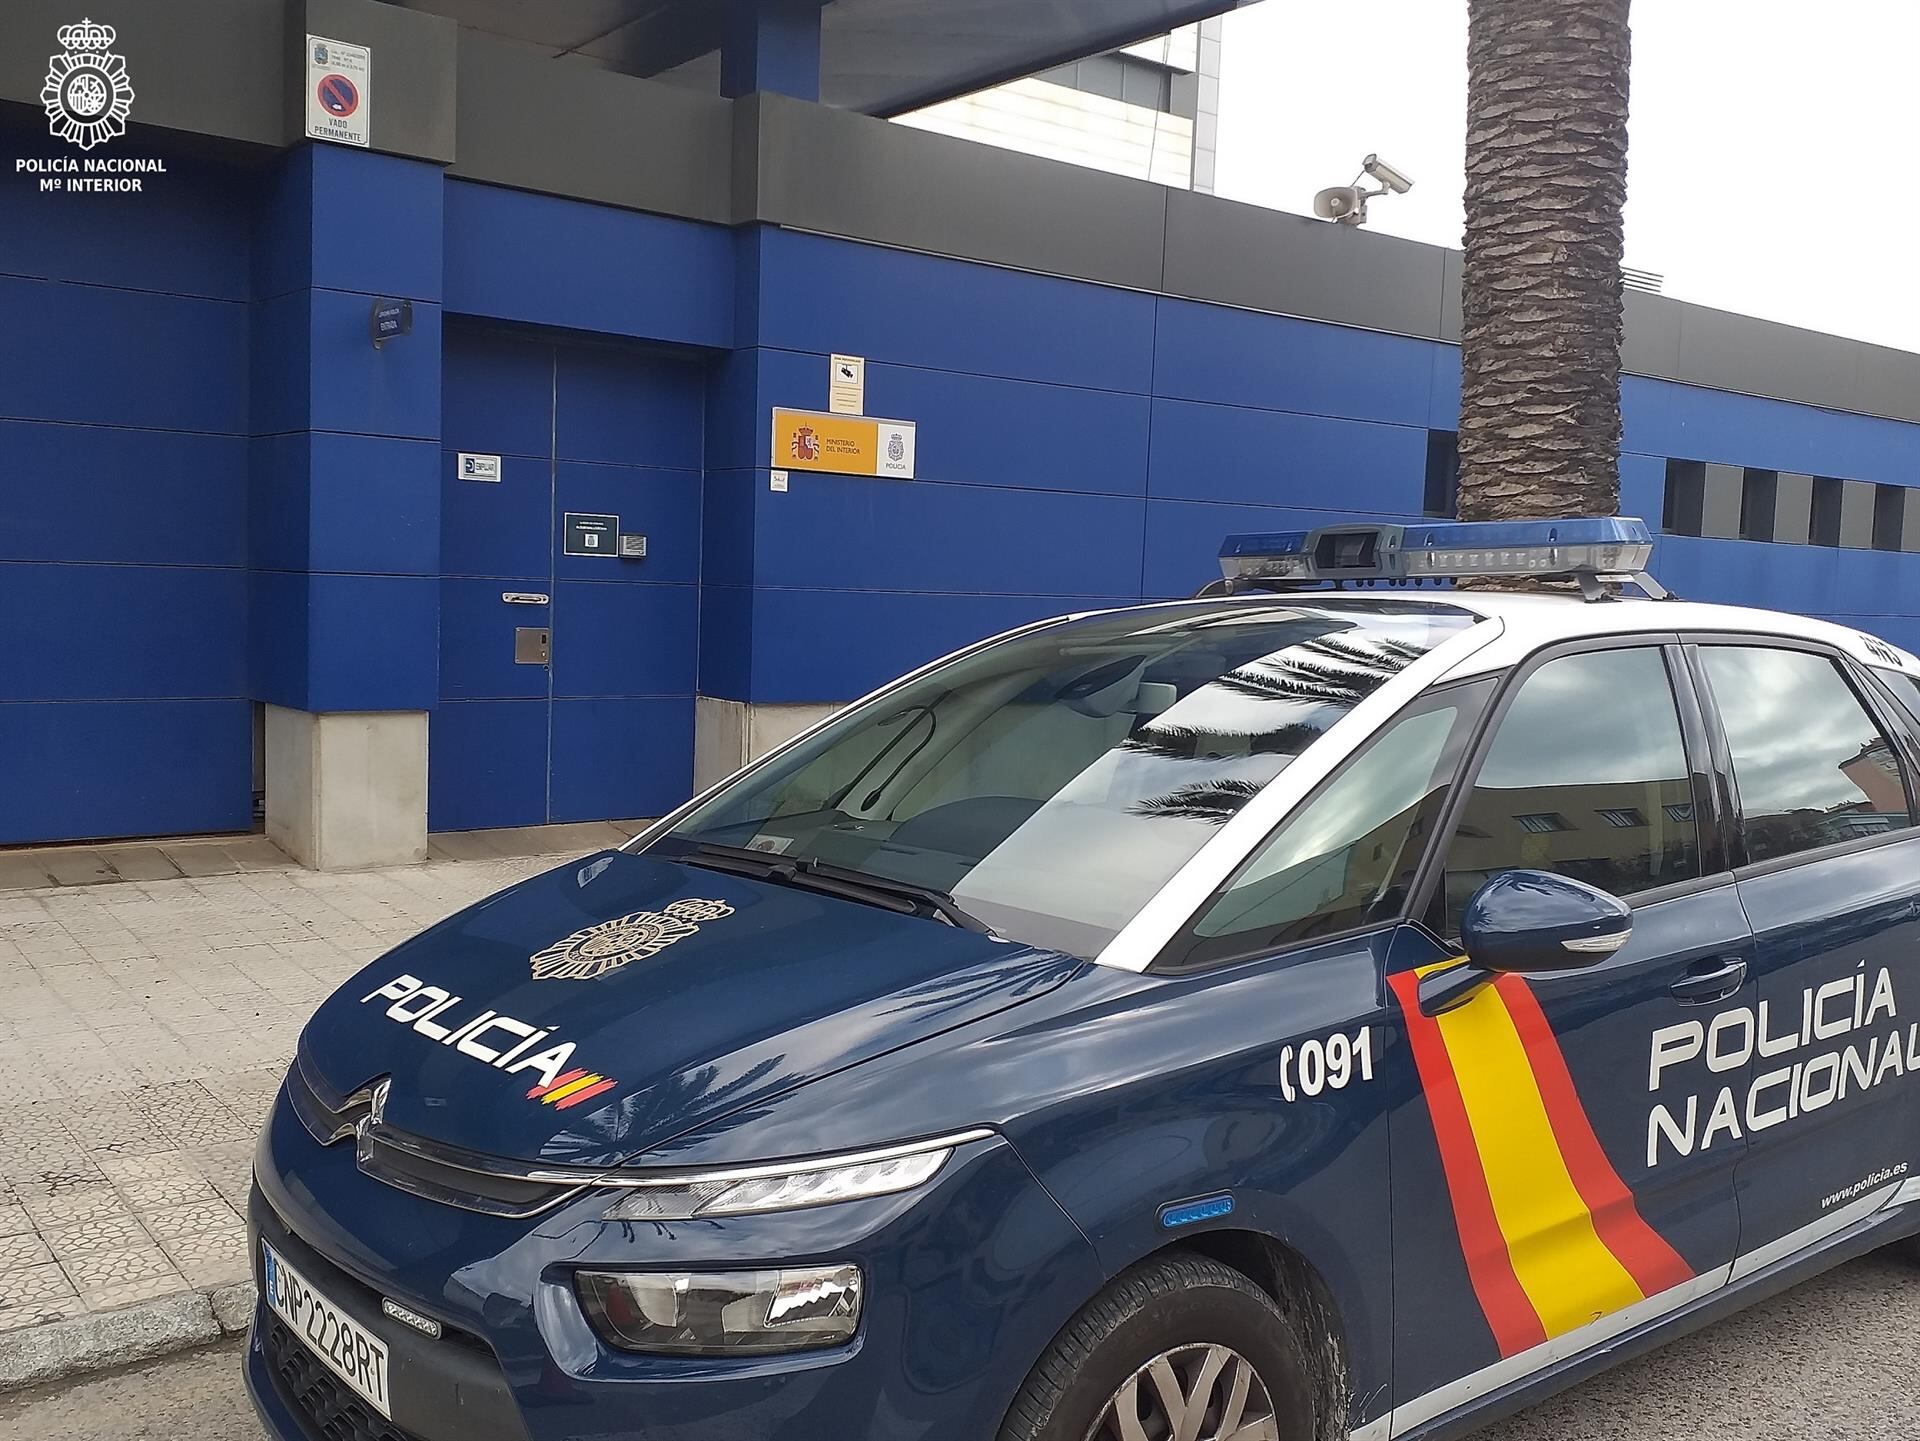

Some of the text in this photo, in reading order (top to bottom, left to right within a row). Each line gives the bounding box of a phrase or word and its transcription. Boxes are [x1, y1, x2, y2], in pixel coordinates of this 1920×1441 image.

[314, 125, 361, 142] PERMANENTE
[328, 117, 348, 129] VADO
[826, 438, 856, 448] MINISTERIO
[826, 445, 861, 455] DEL INTERIOR
[359, 973, 577, 1089] POLICÍA
[1648, 958, 1897, 1092] POLICÍA
[1298, 1025, 1373, 1097] 091
[1647, 1022, 1920, 1168] NACIONAL
[1821, 1161, 1909, 1210] www.policia.es
